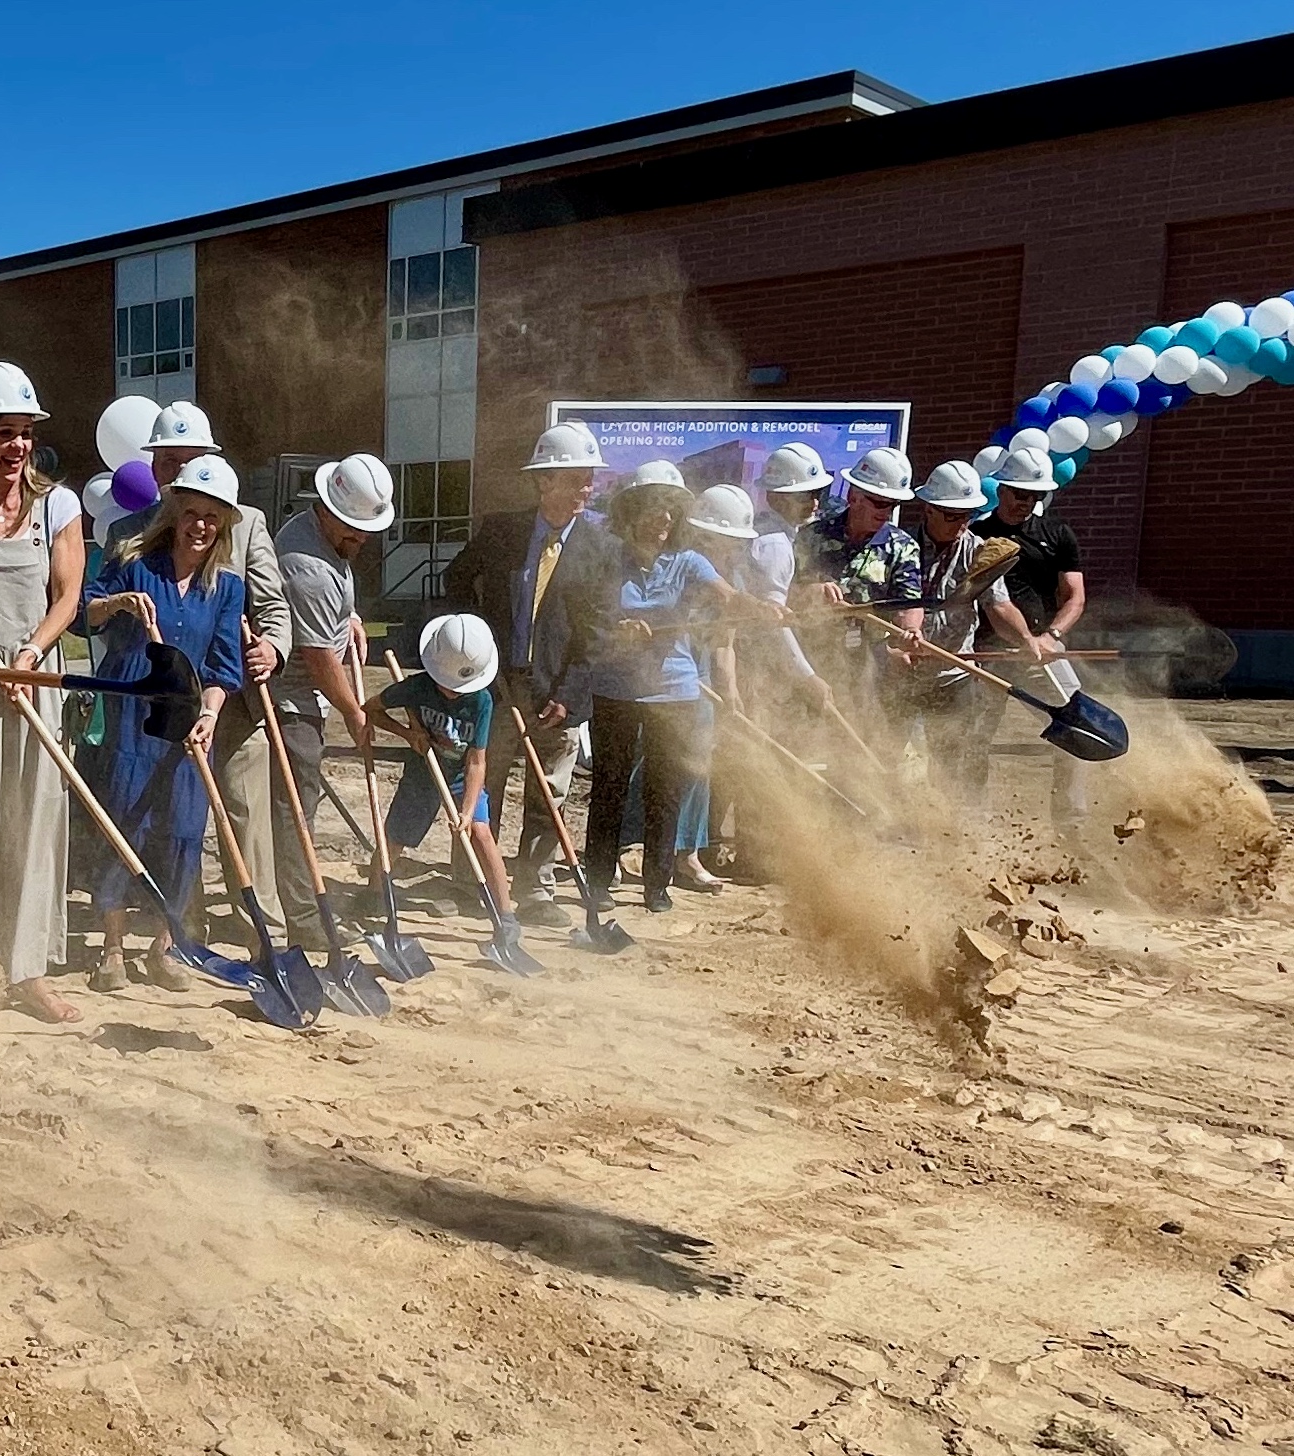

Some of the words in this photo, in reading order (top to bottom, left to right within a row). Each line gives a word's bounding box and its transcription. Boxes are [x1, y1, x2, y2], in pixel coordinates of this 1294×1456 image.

[601, 421, 651, 433] LAYTON
[653, 421, 685, 433] HIGH
[687, 421, 748, 433] ADDITION
[750, 421, 759, 433] &
[761, 421, 821, 433] REMODEL
[600, 435, 654, 446] OPENING
[655, 435, 685, 446] 2026
